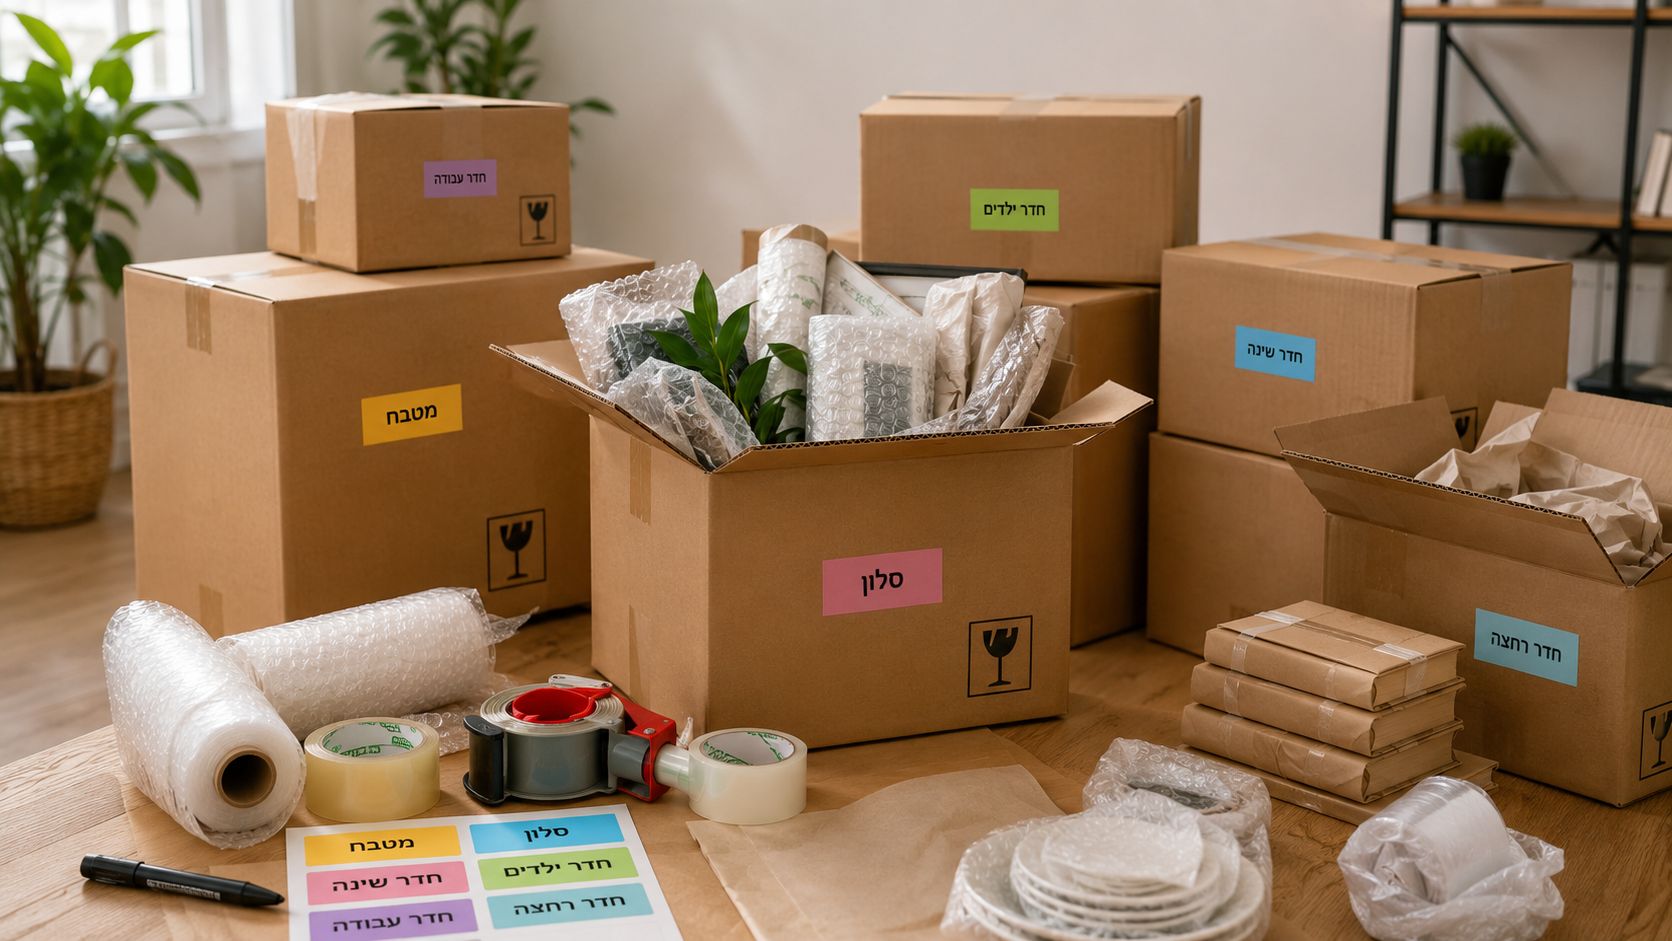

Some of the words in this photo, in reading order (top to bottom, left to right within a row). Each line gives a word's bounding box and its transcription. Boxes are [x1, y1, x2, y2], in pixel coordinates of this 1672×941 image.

[433, 173, 464, 185] עבודה
[466, 173, 487, 184] חדר
[983, 201, 1017, 216] ילדים
[1019, 204, 1046, 217] חדר
[1247, 343, 1276, 359] שינה
[1278, 349, 1303, 364] חדר
[386, 404, 438, 426] מטבח
[860, 568, 904, 598] סלון
[1490, 631, 1529, 655] רחצה
[1533, 643, 1562, 663] חדר
[523, 826, 569, 843] סלון
[349, 838, 415, 852] מטבח
[503, 862, 561, 878] ילדים
[567, 859, 612, 871] חדר
[332, 877, 388, 892] שינה
[395, 873, 443, 886] חדר
[513, 900, 575, 916] רחצה
[581, 896, 626, 909] חדר
[333, 917, 401, 933] עבודה
[408, 912, 454, 925] חדר
